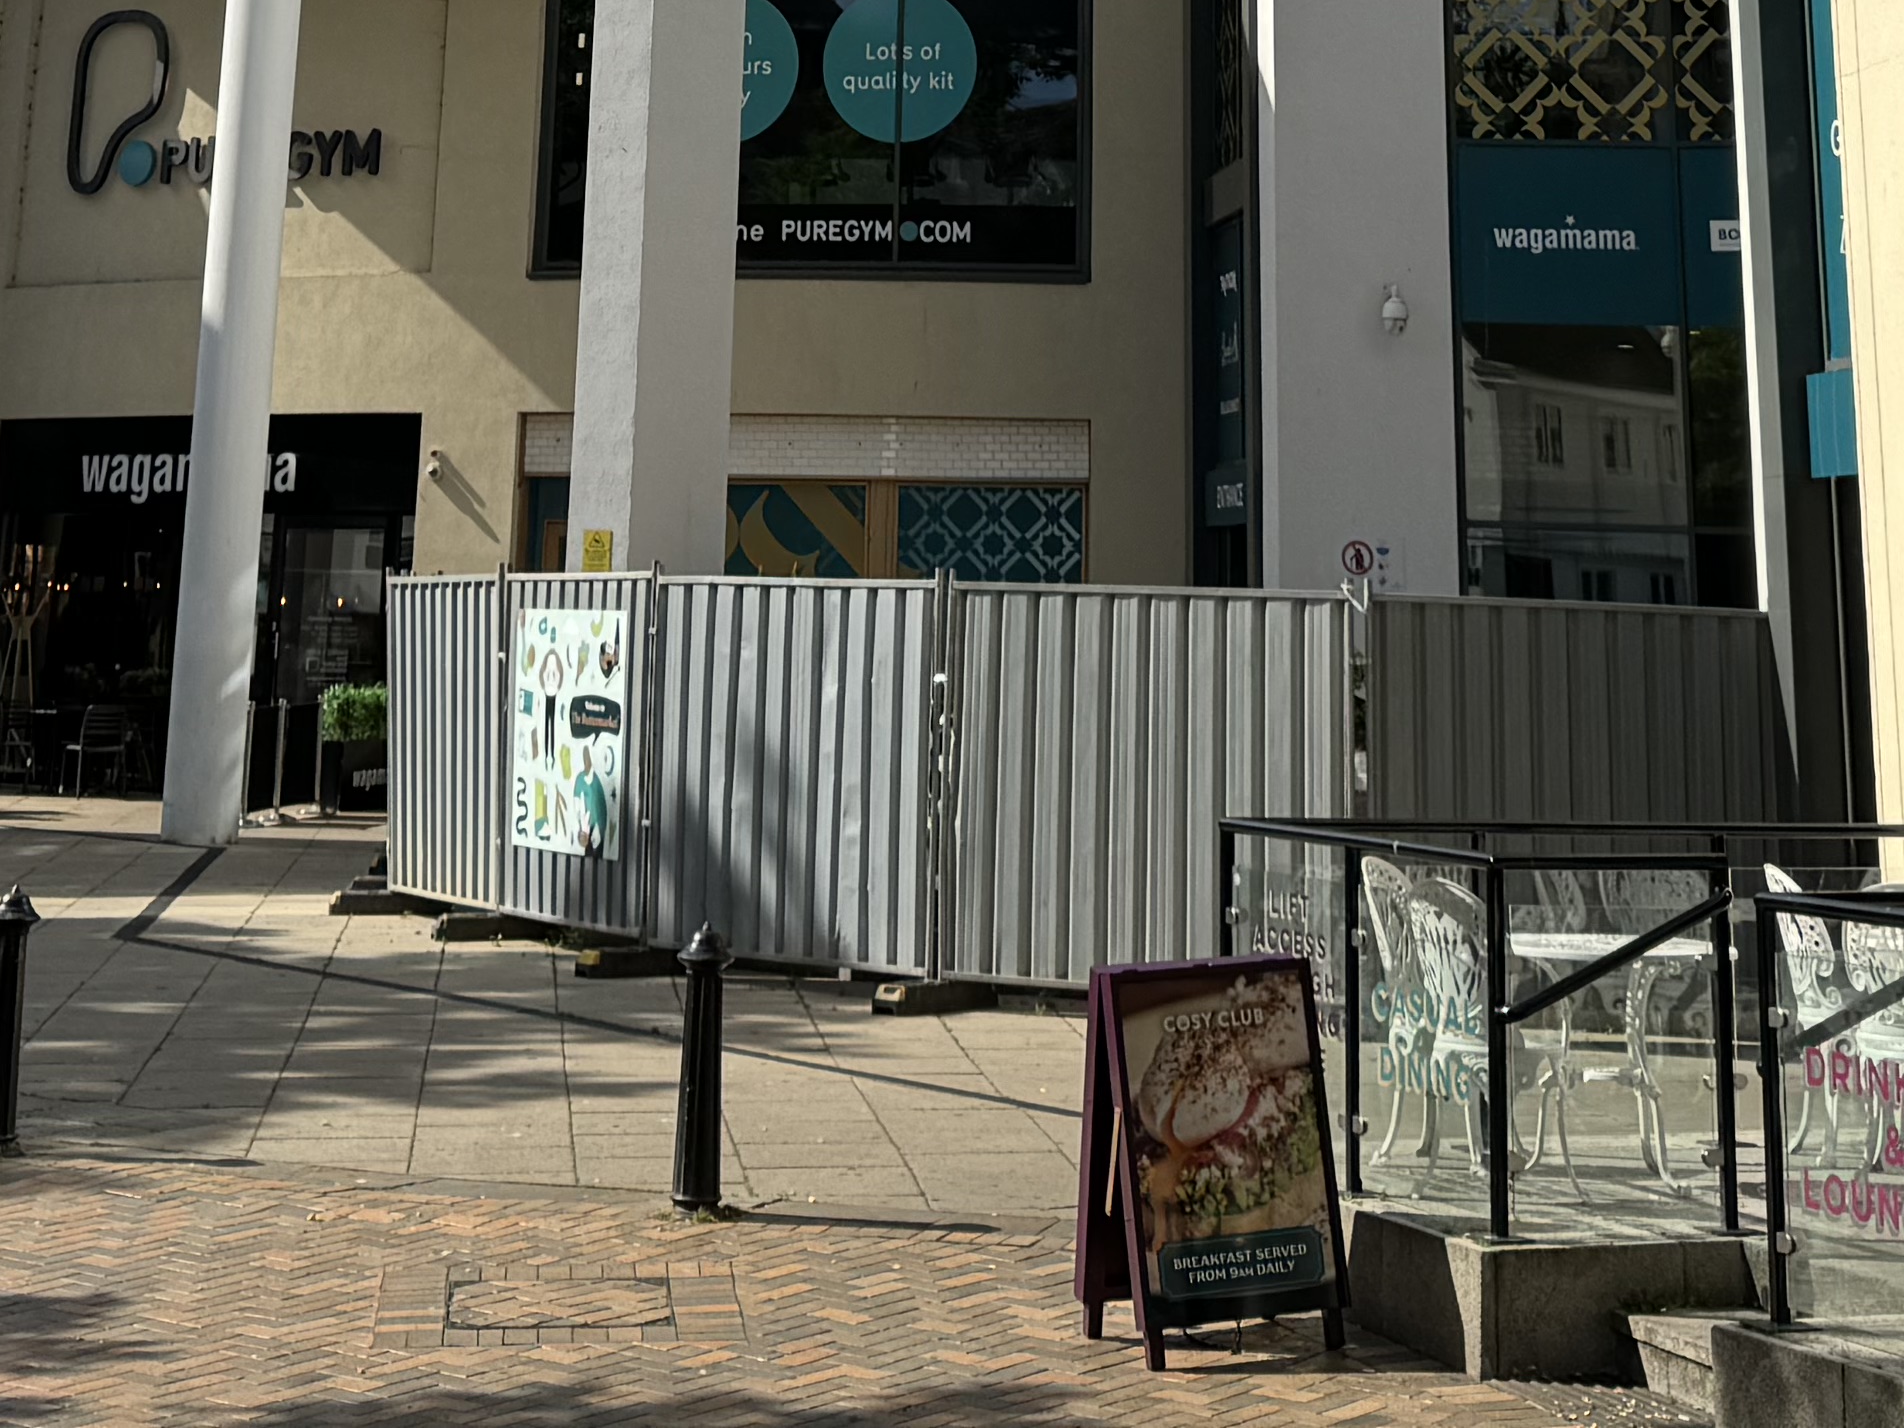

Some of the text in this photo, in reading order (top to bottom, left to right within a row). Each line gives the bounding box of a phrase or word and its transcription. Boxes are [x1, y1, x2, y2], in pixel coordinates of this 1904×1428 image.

[865, 43, 942, 61] Lots of
[843, 71, 954, 94] quality kit
[160, 128, 382, 185] PUGYM
[1494, 228, 1637, 254] wagamama
[81, 451, 297, 504] wagaa
[1269, 890, 1310, 922] LIFT
[1253, 924, 1327, 961] ACCESS
[1164, 1008, 1265, 1032] COSY CLUB
[1371, 982, 1481, 1039] CASUAL
[1377, 1046, 1471, 1106] DINING
[1173, 1243, 1308, 1271] BREAKFAST SERVED
[1188, 1266, 1227, 1284] FROM
[1257, 1259, 1295, 1277] DAILY
